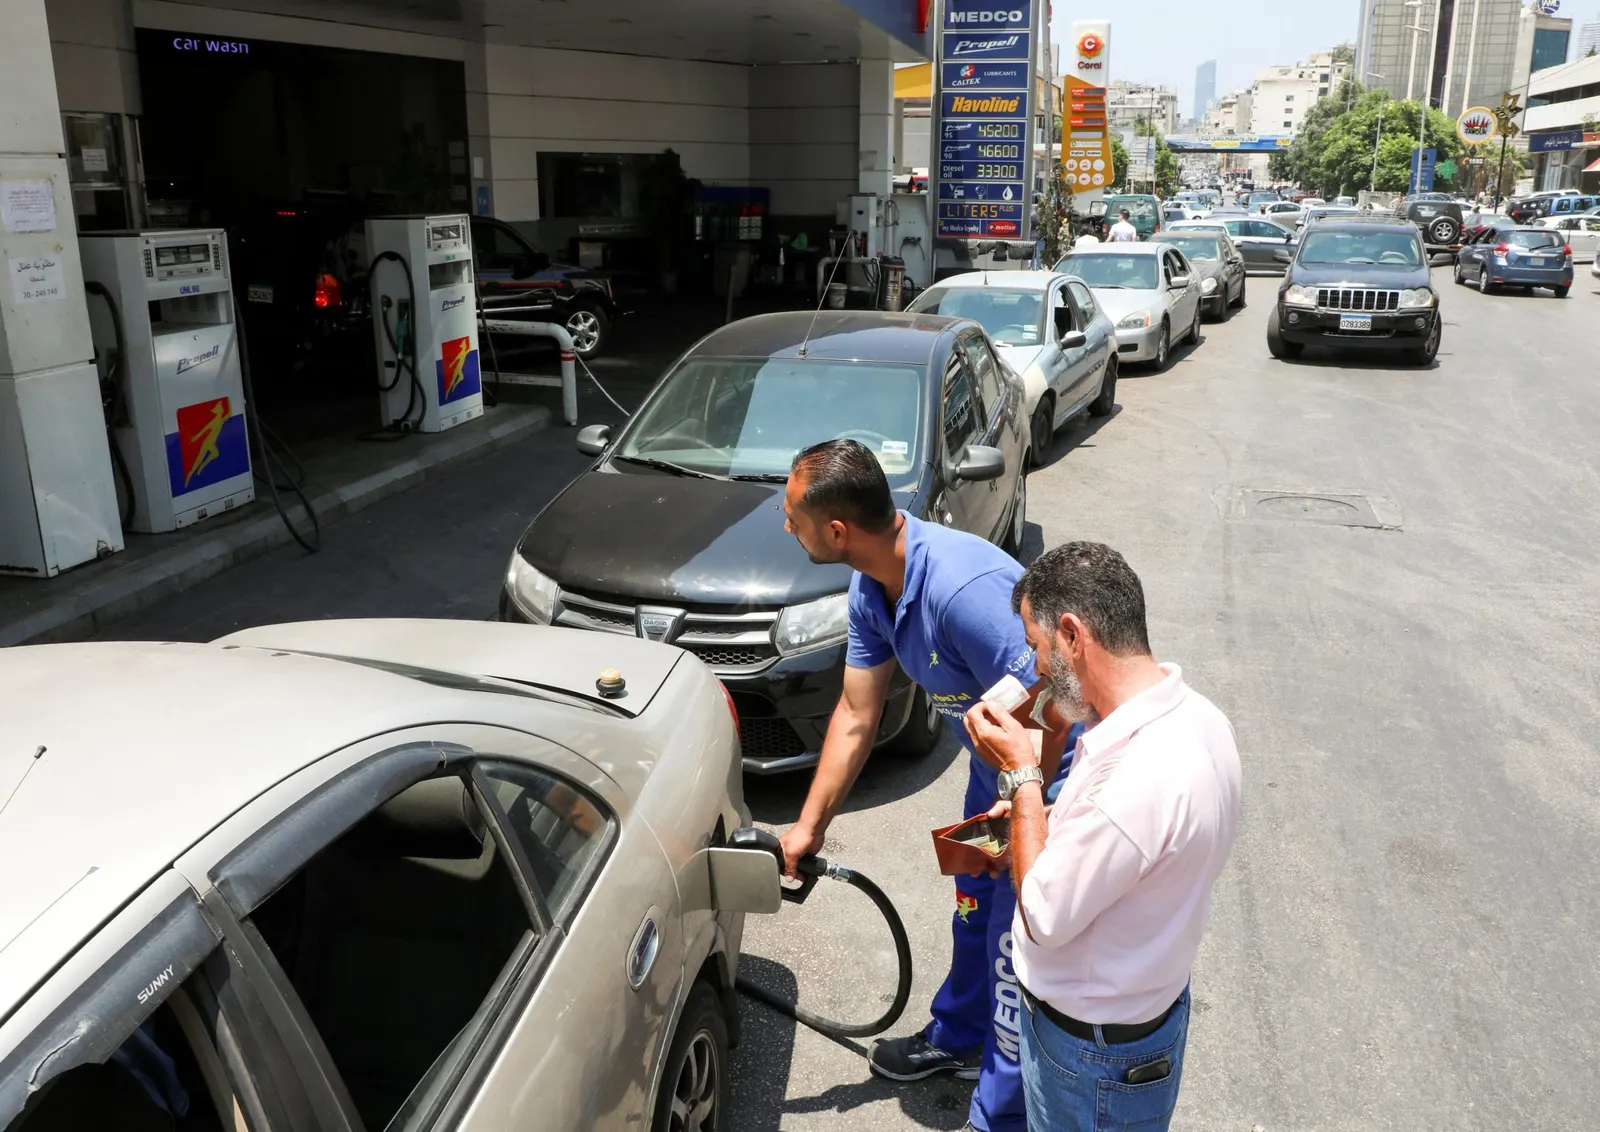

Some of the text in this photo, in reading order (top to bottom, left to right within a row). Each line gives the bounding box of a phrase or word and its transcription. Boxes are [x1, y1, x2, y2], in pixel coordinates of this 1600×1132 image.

[950, 10, 1023, 23] MEDCO
[173, 37, 200, 51] car
[953, 35, 1019, 54] Propell
[1077, 61, 1102, 70] Coral
[952, 77, 981, 87] CALTEX
[952, 96, 1020, 113] Havoline
[945, 123, 972, 132] Propell
[978, 124, 1018, 138] 45200
[978, 144, 1018, 158] 46600
[943, 165, 964, 173] Diesel
[943, 171, 952, 179] oil
[977, 165, 1017, 178] 33300
[947, 203, 998, 218] LITERS
[177, 345, 219, 373] Propell
[137, 964, 174, 1005] SUNNY
